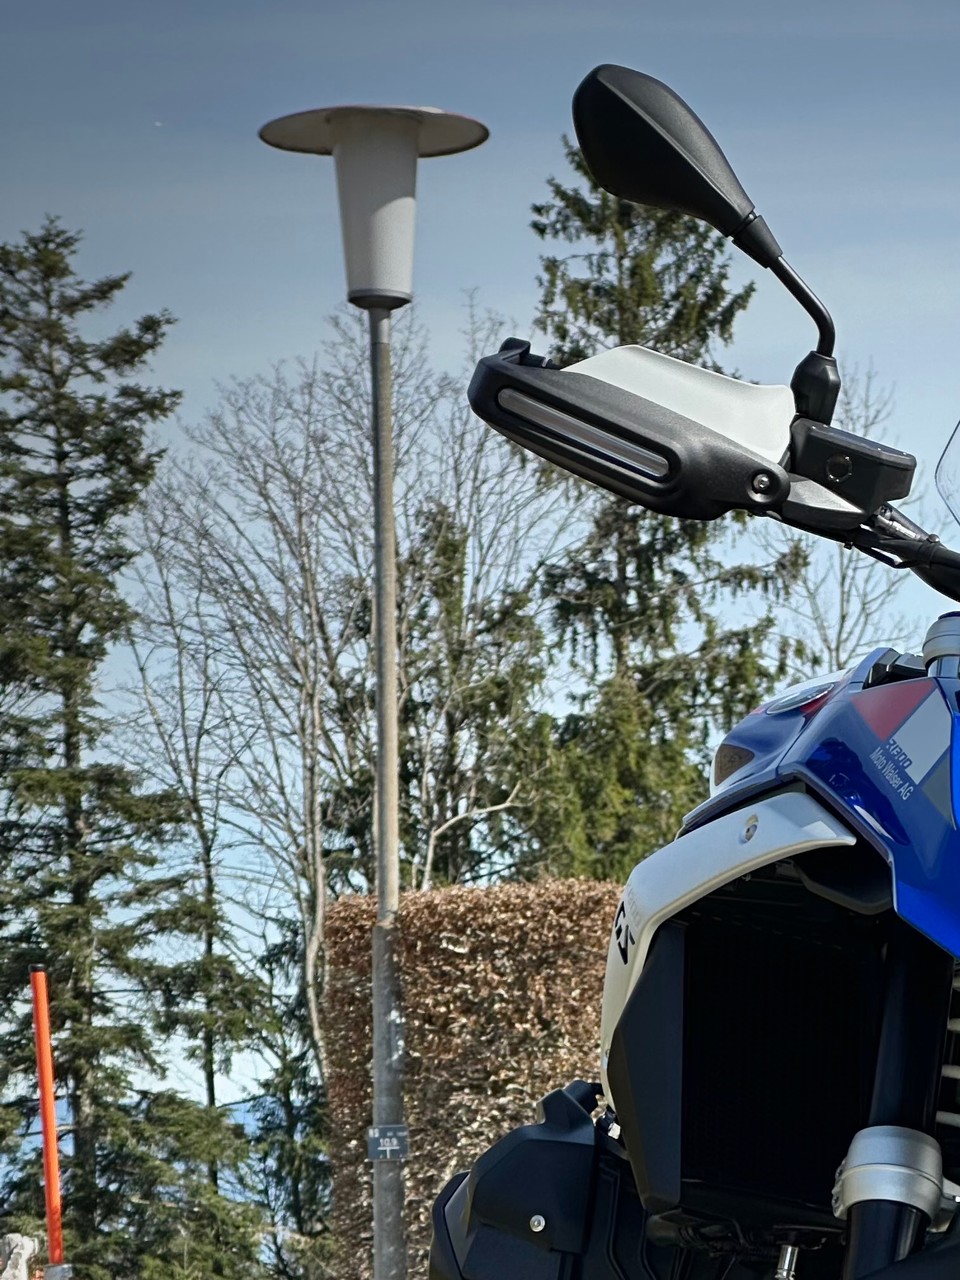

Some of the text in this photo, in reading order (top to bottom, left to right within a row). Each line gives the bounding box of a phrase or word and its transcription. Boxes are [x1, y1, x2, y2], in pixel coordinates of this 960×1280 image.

[869, 746, 887, 770] Moto
[897, 782, 914, 801] AG
[614, 900, 636, 966] GS
